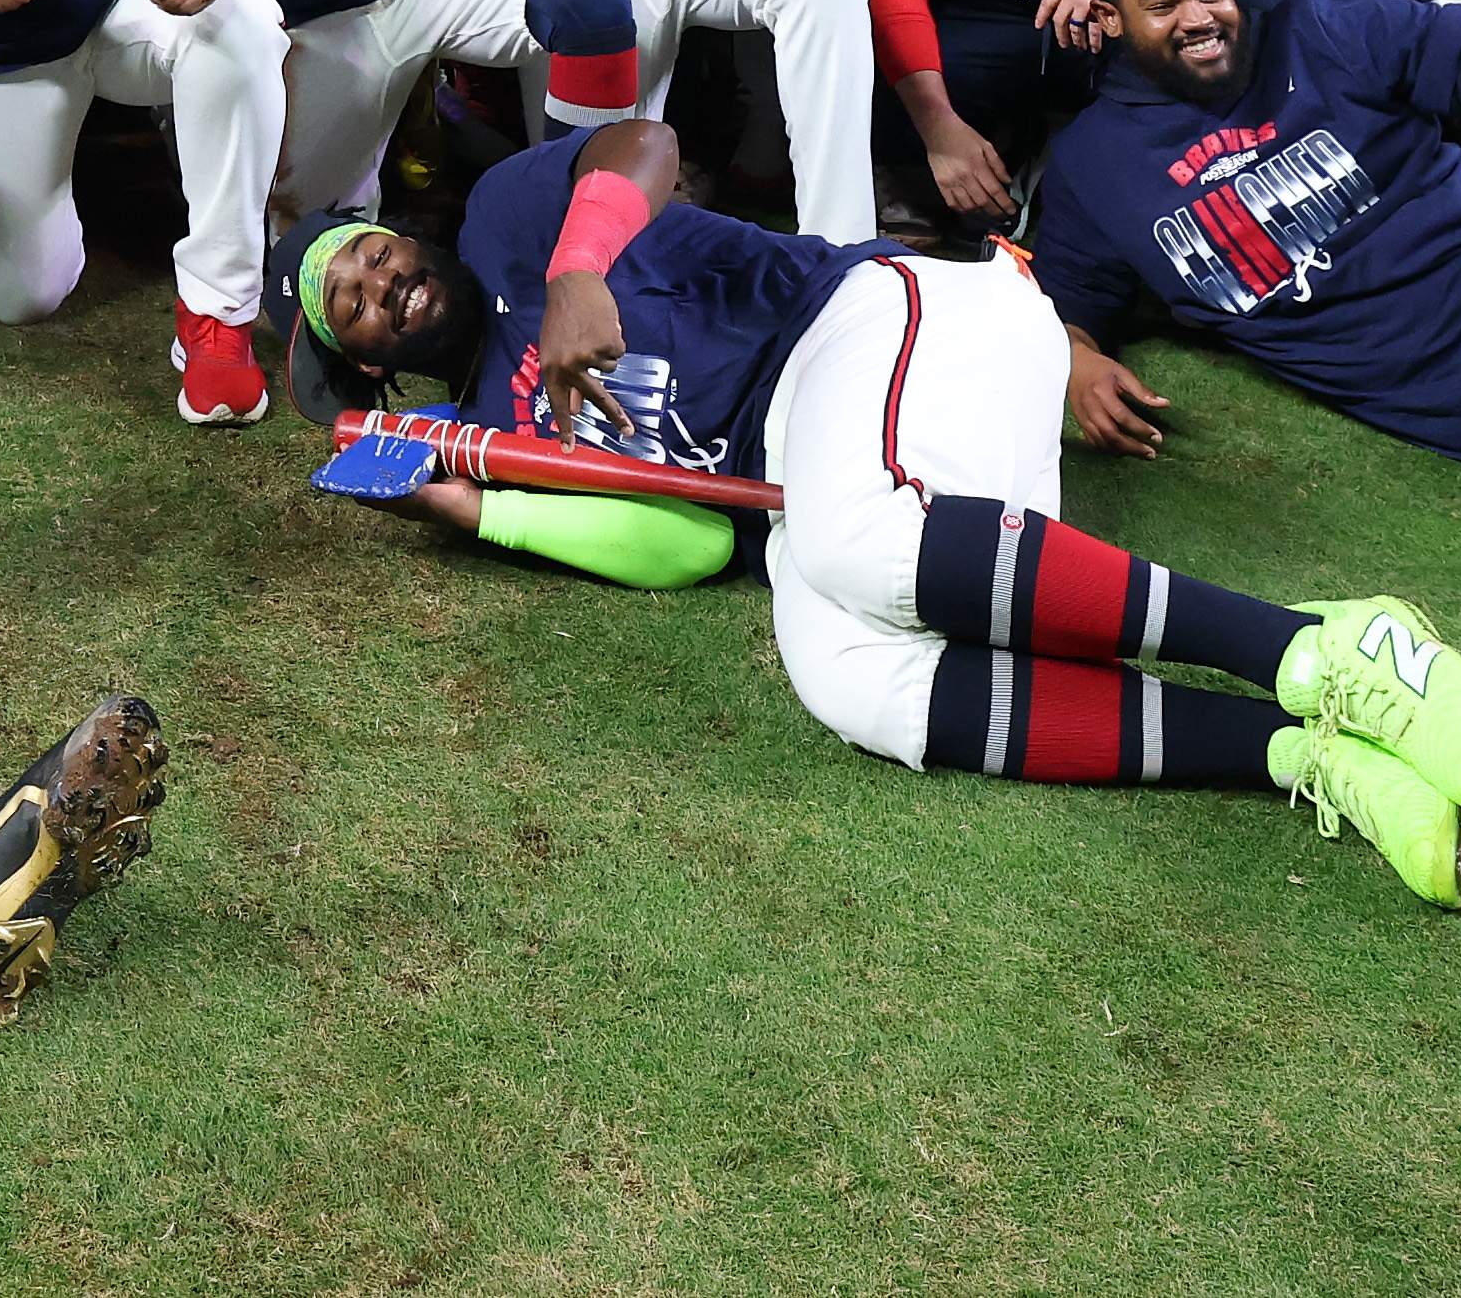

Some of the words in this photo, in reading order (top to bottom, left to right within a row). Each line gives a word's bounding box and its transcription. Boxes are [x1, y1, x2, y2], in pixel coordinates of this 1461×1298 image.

[1167, 119, 1280, 189] BRAVES
[1199, 148, 1259, 186] POSTSEASON
[1153, 128, 1380, 314] CLINCHED
